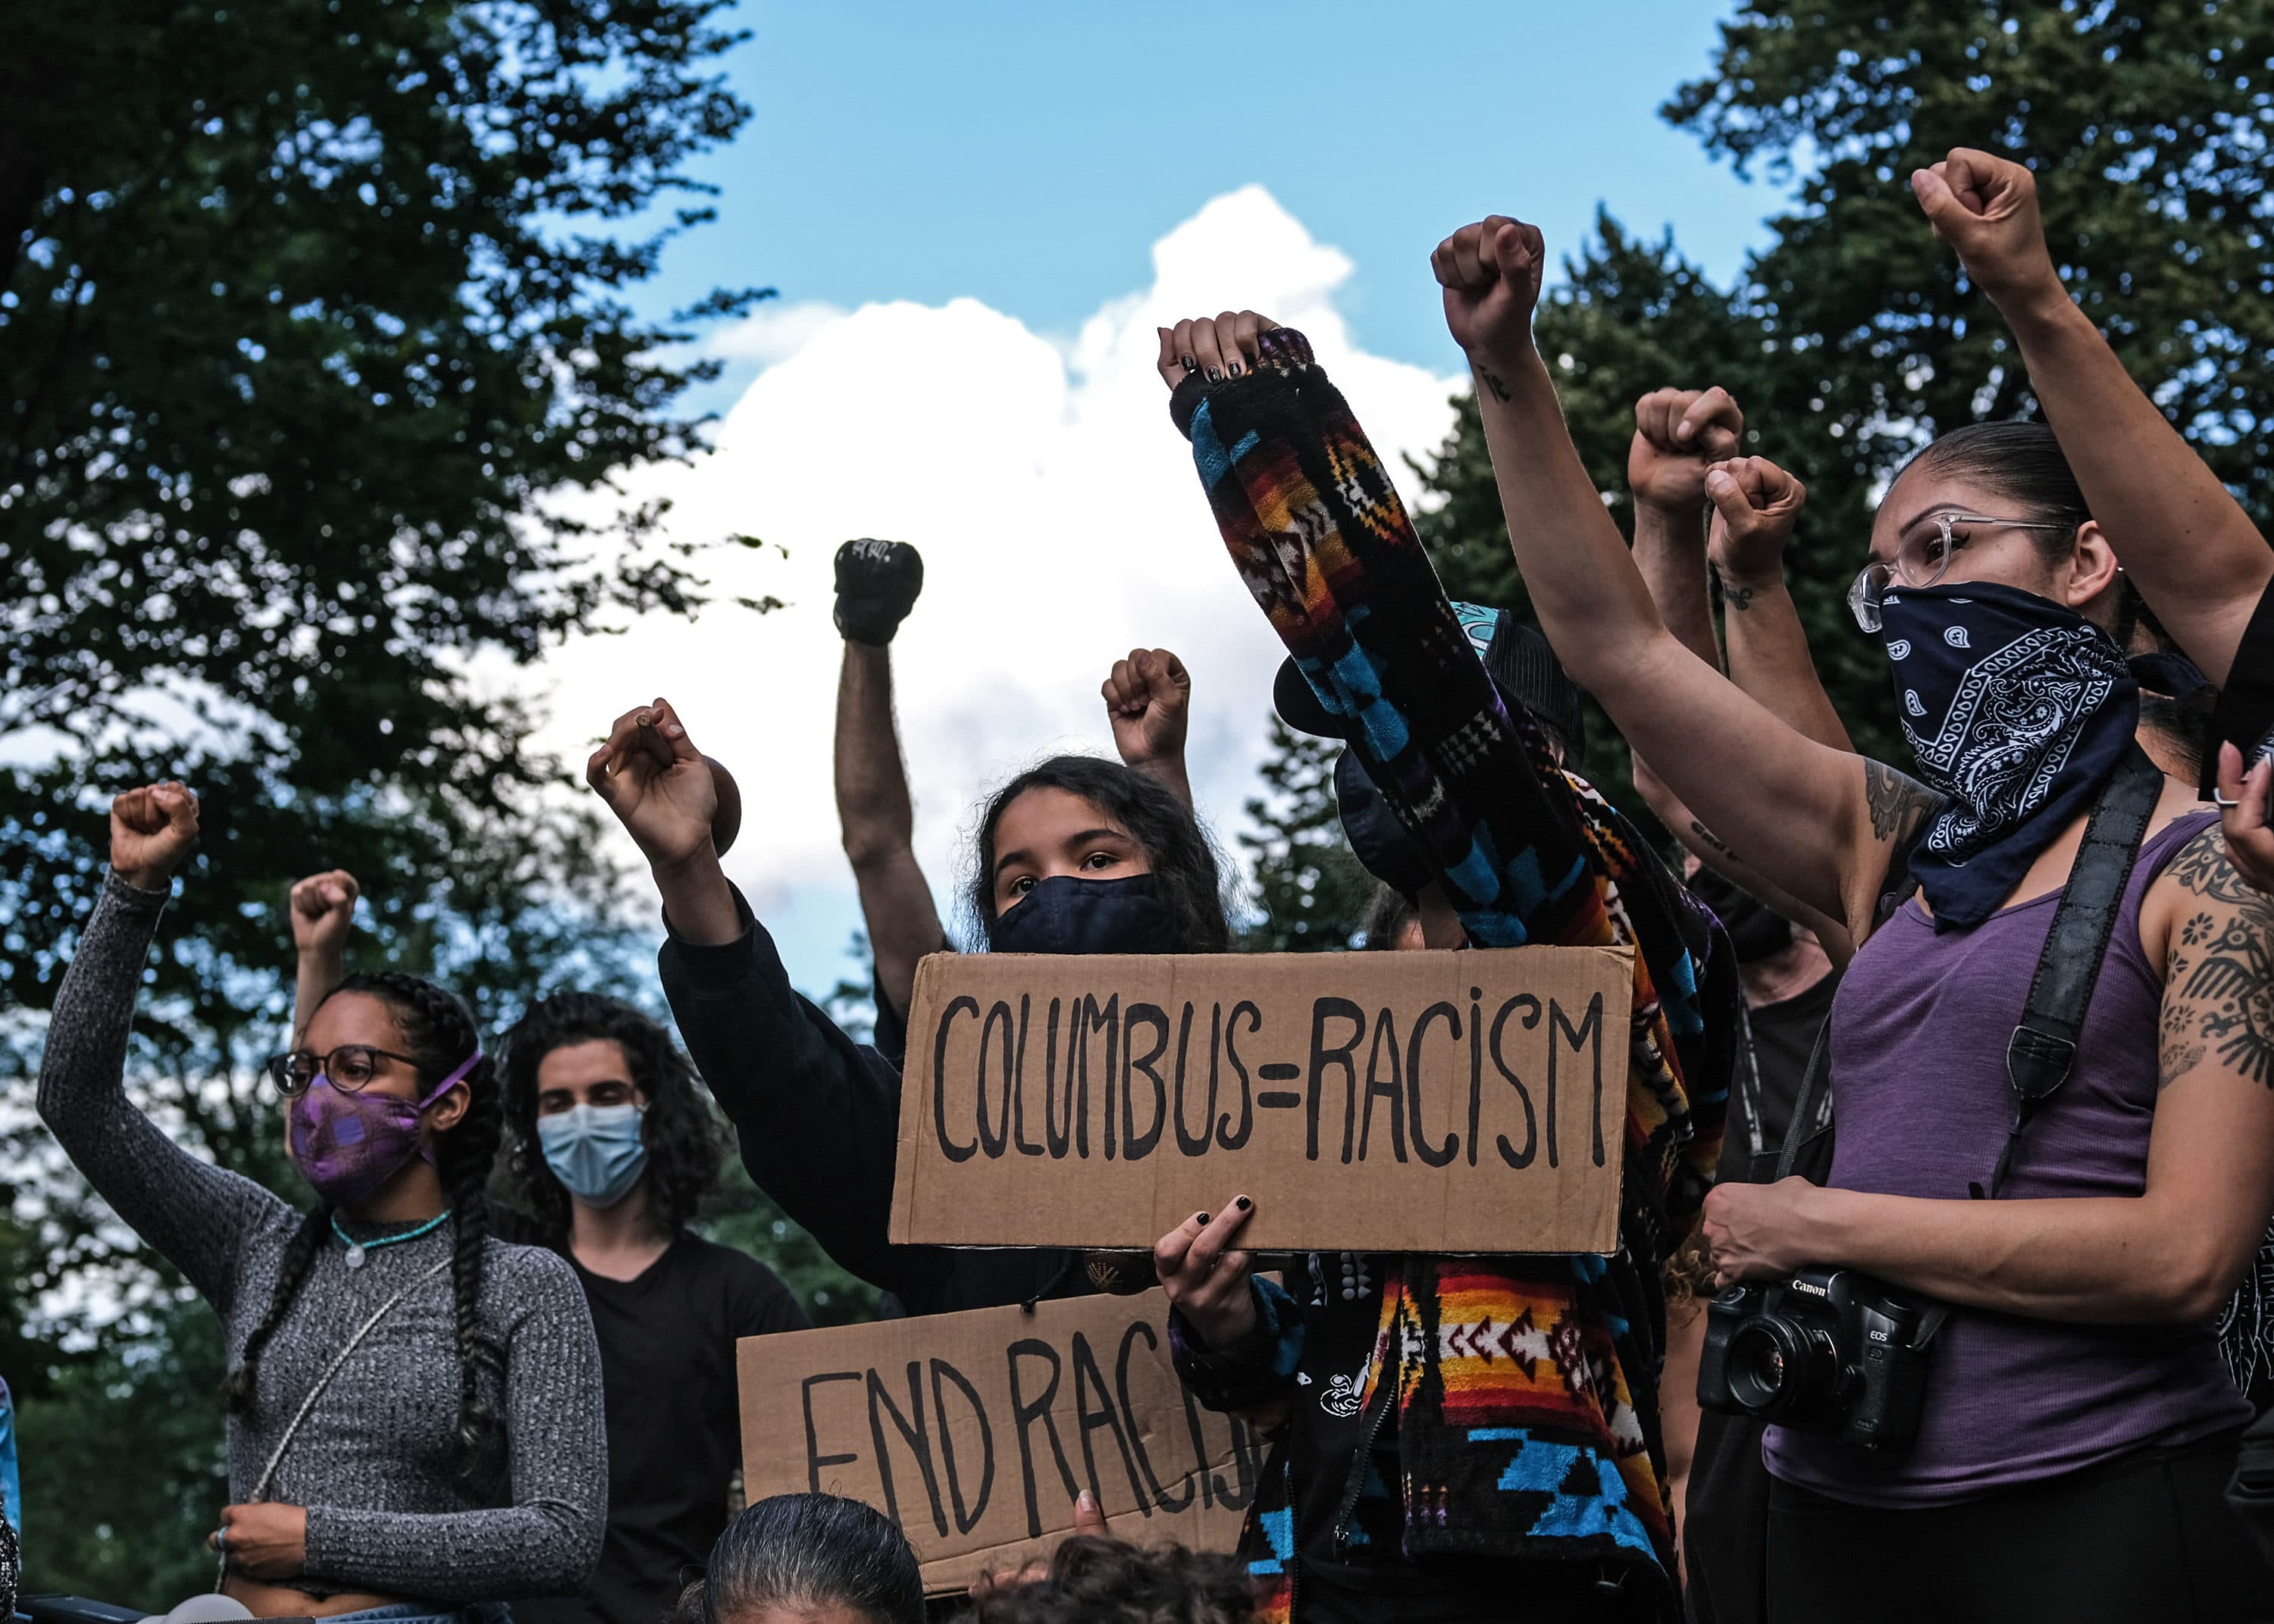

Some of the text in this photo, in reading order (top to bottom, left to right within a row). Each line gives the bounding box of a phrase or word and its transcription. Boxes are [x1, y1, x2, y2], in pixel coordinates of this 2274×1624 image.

[1793, 1280, 1826, 1297] Canon
[1870, 1331, 1887, 1341] EOS
[801, 1357, 995, 1537] END
